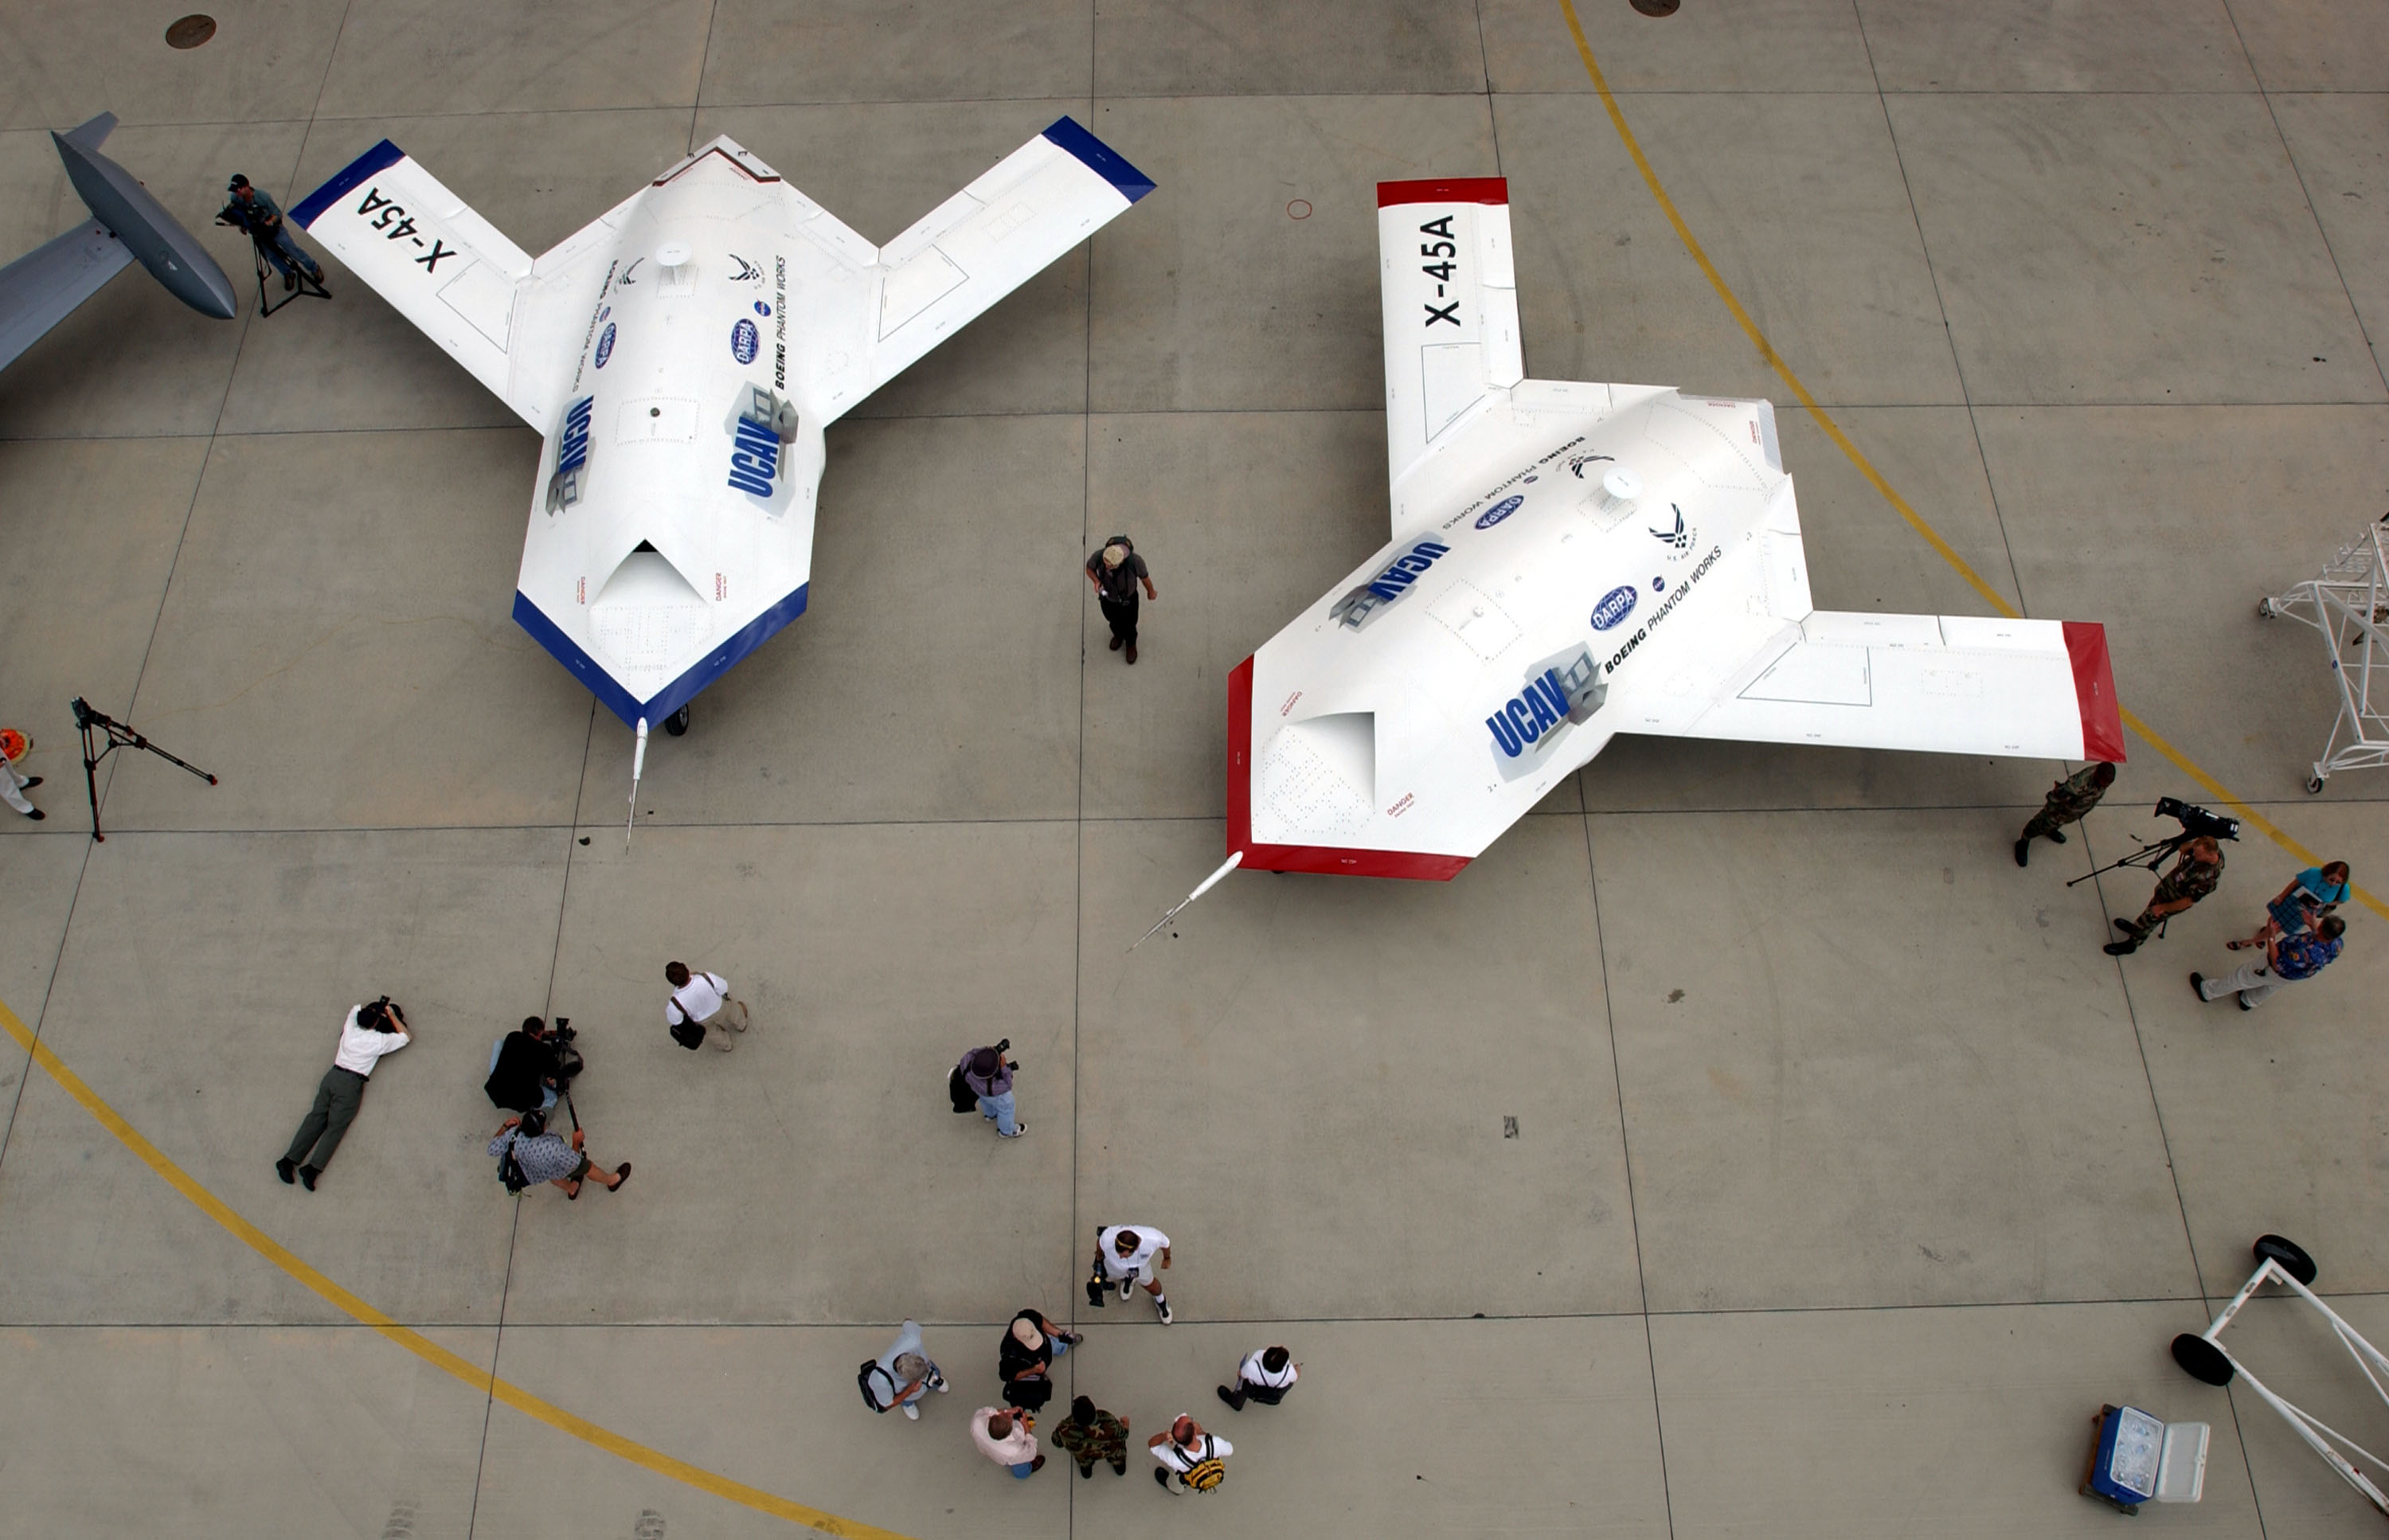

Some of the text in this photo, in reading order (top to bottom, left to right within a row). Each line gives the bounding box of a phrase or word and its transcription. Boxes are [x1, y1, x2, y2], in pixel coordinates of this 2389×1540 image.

[357, 187, 457, 274] X-45A
[1419, 215, 1460, 327] X-45A
[599, 325, 615, 365] DARPA
[737, 322, 755, 362] DARPA
[775, 255, 786, 390] BOEING PHANTOM WORKS
[559, 395, 594, 475] UCAV
[728, 416, 780, 498] UCAV
[1538, 436, 1585, 465] BOEING
[1484, 464, 1537, 500] PHANTOM
[1442, 500, 1484, 530] WORKS
[1479, 495, 1523, 528] DARPA
[1367, 541, 1451, 601] UCAV
[1593, 588, 1635, 629] DARPA
[1604, 545, 1722, 675] BOEING PHANTOM WORKS
[1485, 668, 1571, 758] UCAV
[1387, 792, 1414, 816] DANGER
